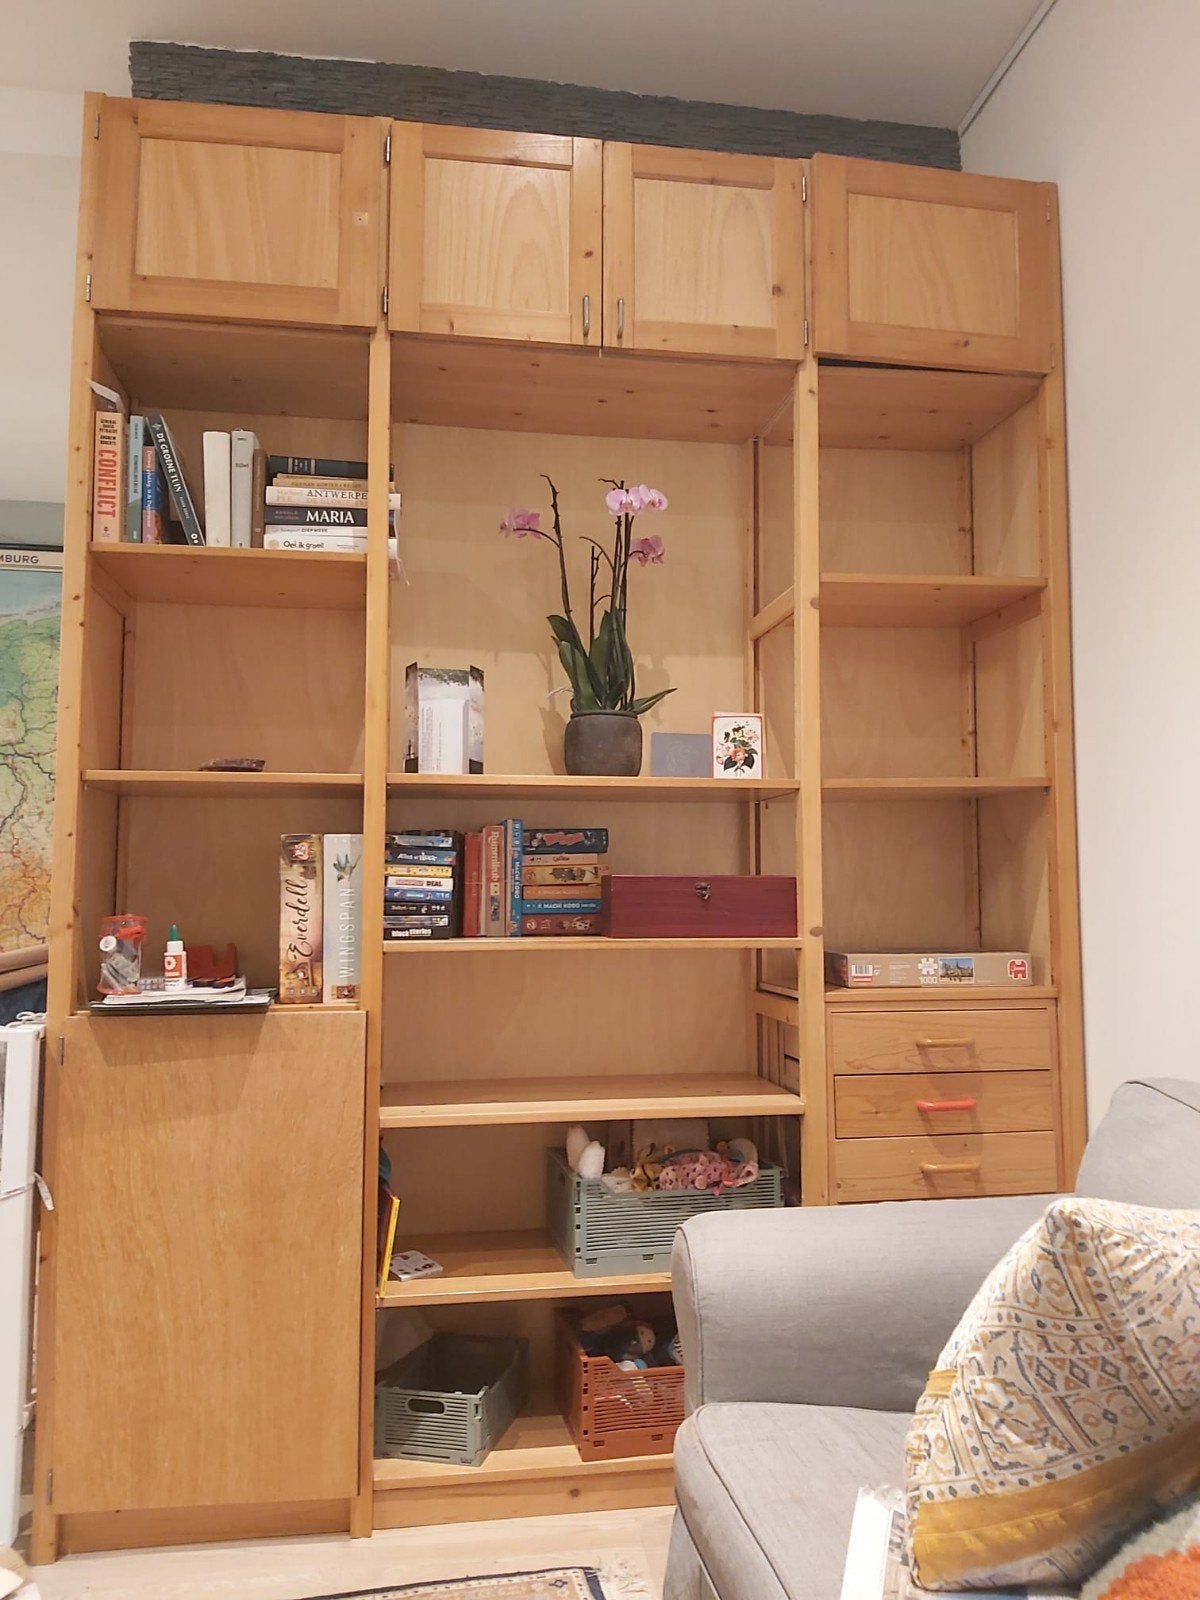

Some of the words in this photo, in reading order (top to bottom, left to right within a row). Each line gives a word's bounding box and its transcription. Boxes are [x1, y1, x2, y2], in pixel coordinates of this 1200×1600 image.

[156, 432, 165, 443] DE
[160, 444, 175, 473] GROENE
[97, 449, 117, 518] CONFLICT
[171, 474, 182, 493] TUIN
[306, 489, 368, 500] ANTWERPE
[306, 510, 355, 523] MARIA
[285, 879, 313, 963] Everdell
[339, 888, 355, 978] WINGSPAN
